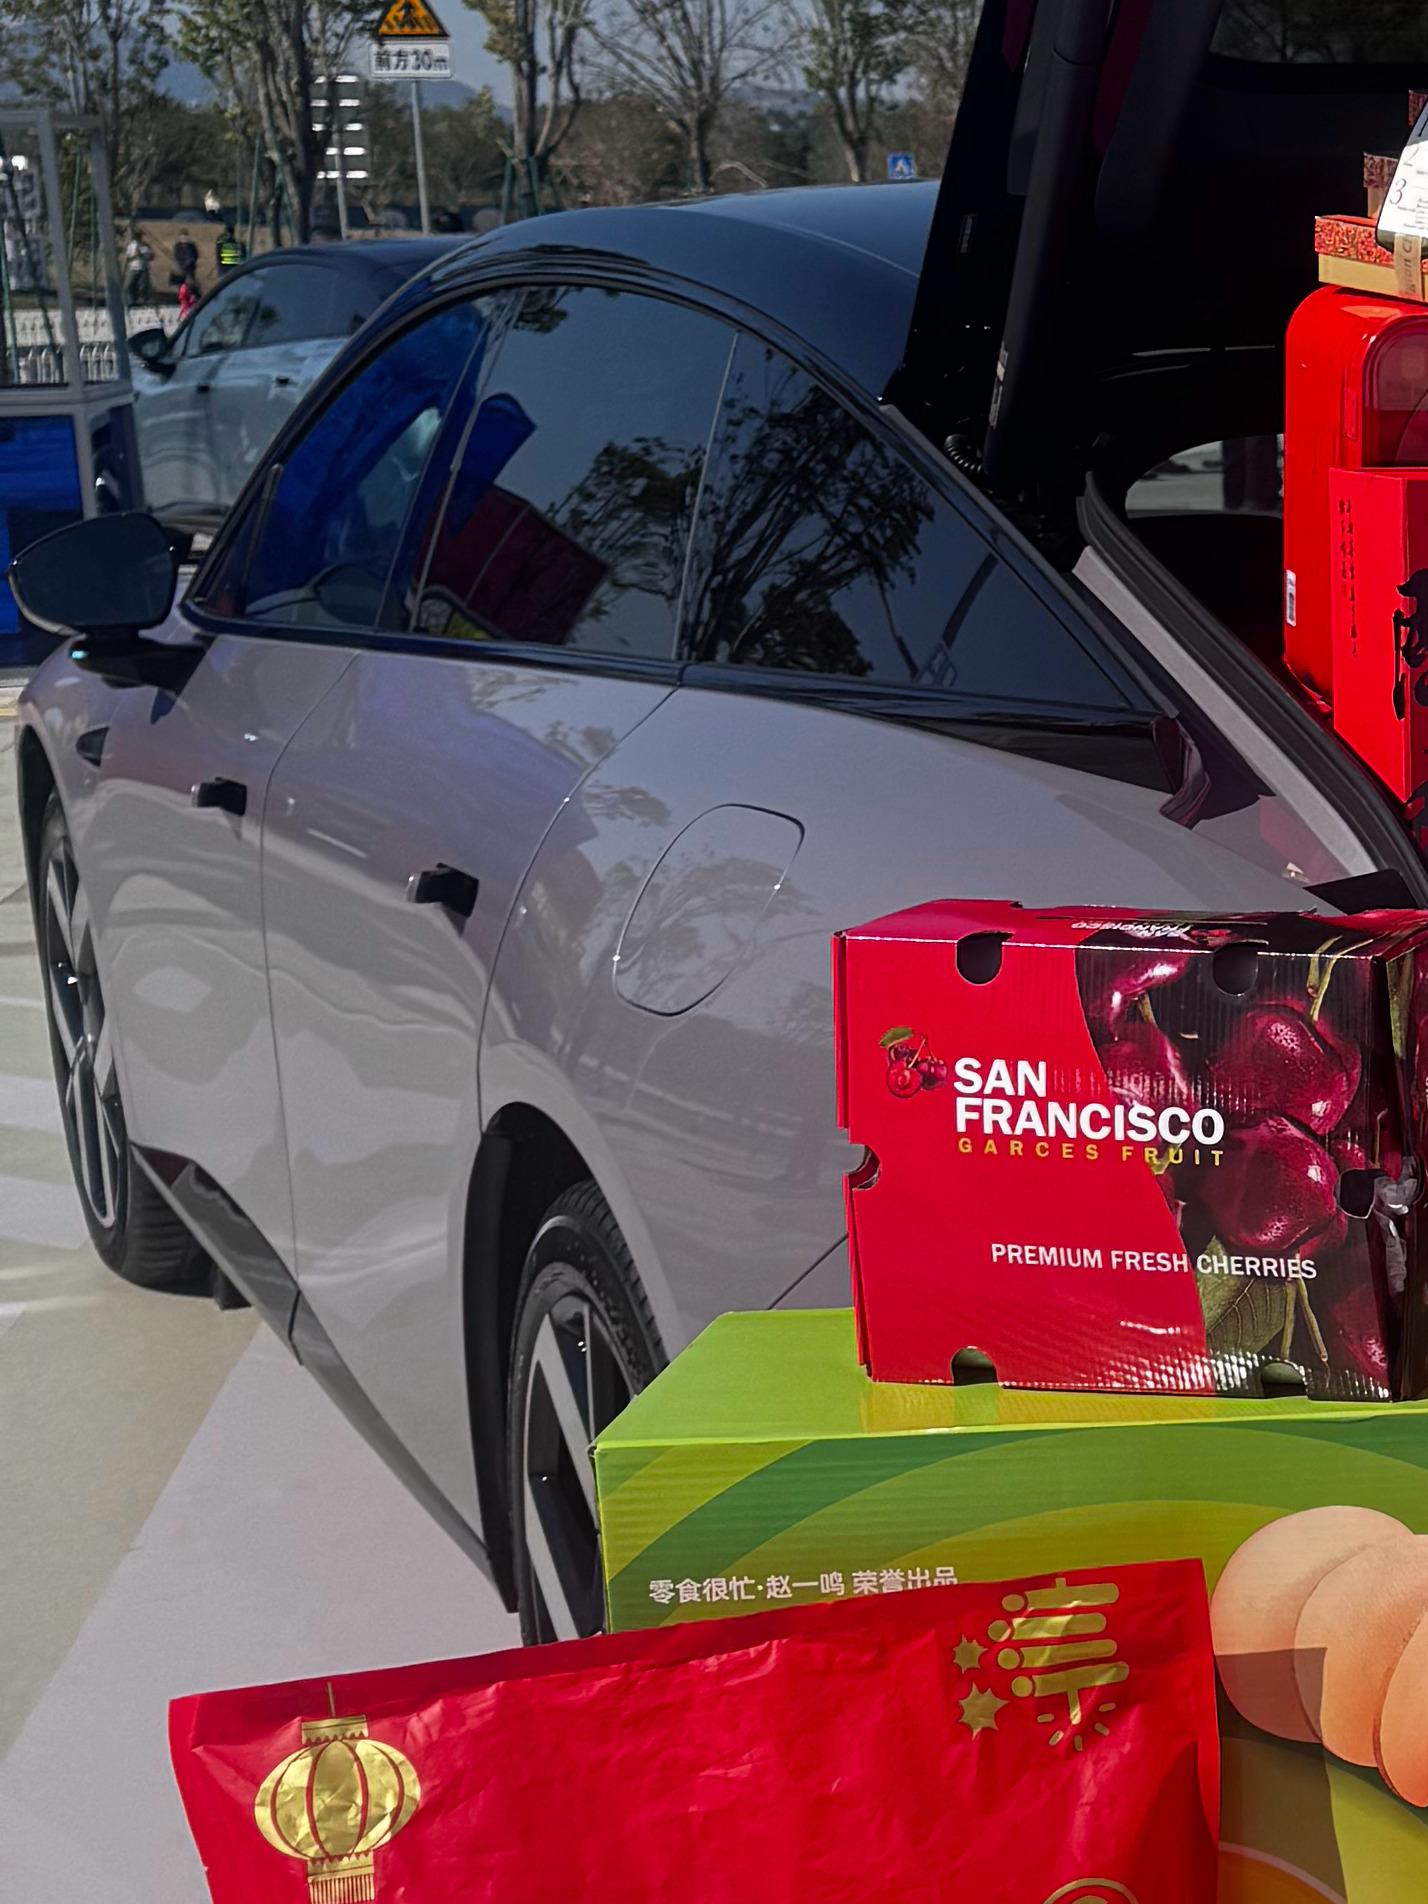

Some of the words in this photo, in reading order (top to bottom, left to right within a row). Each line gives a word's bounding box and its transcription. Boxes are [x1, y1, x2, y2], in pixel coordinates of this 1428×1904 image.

[954, 1057, 1047, 1097] SAN
[956, 1097, 1225, 1146] FRANCISCO
[957, 1137, 1099, 1161] GARCES
[1121, 1146, 1225, 1167] FRUIT
[991, 1242, 1103, 1269] PREMIUM
[1109, 1248, 1189, 1274] FRESH
[1196, 1253, 1318, 1280] CHERRIES
[649, 1572, 846, 1604] 零食很忙·赵一鸣
